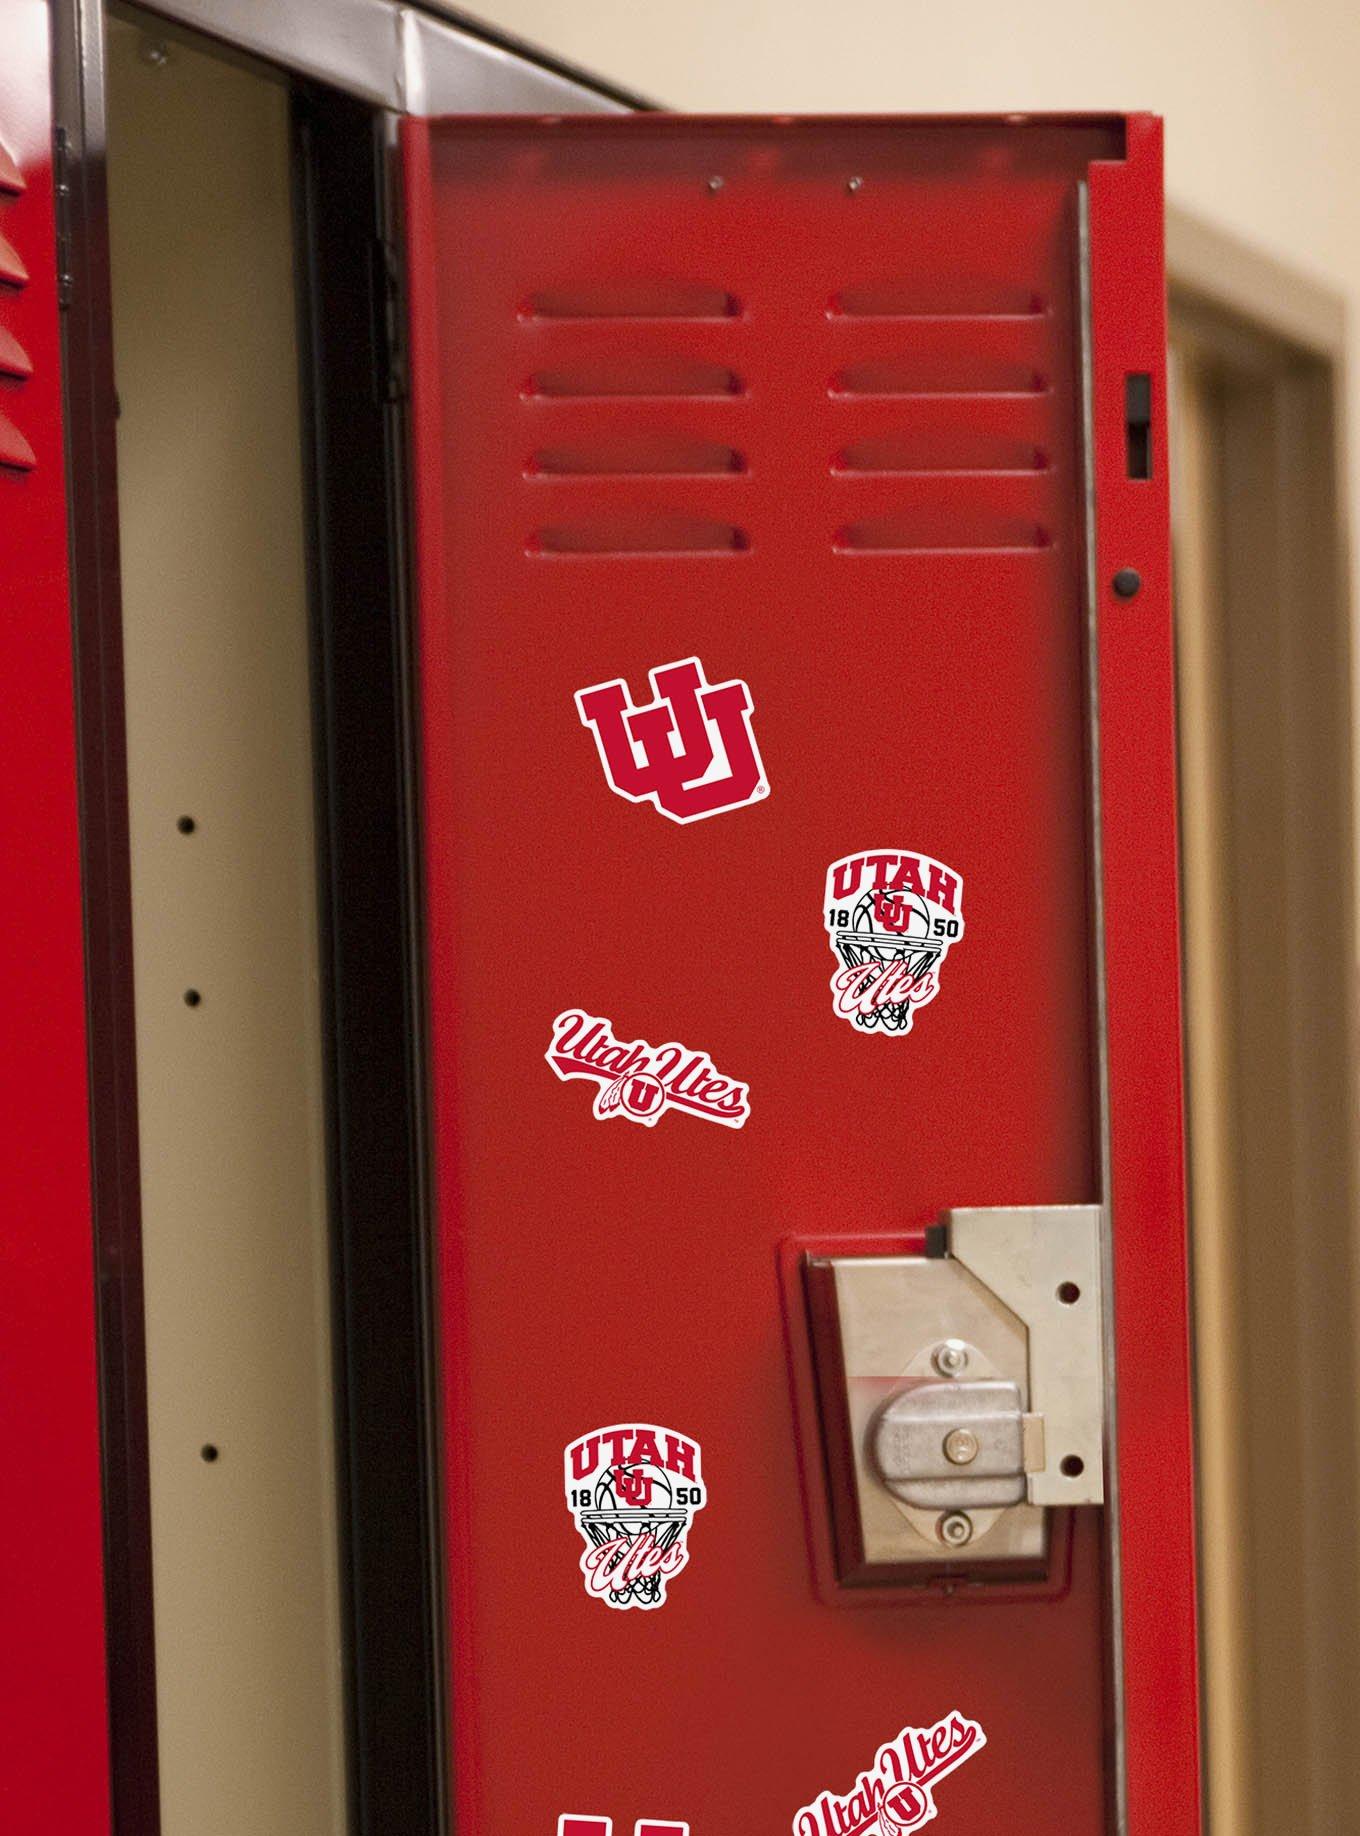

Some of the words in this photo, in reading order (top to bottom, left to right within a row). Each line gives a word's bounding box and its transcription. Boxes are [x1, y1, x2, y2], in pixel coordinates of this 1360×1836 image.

[833, 855, 957, 915] UTAH
[829, 908, 850, 928] 18
[933, 918, 959, 937] 50
[836, 959, 934, 1014] Utes
[555, 1014, 650, 1074] Utah
[655, 1047, 744, 1111] Utes
[627, 1079, 659, 1112] U
[571, 1429, 696, 1483] UTAH
[571, 1489, 591, 1507] 18
[676, 1487, 701, 1505] 50
[585, 1532, 684, 1592] Utes
[799, 1776, 885, 1836] Utah
[880, 1717, 967, 1782] Utes
[886, 1786, 921, 1821] U
